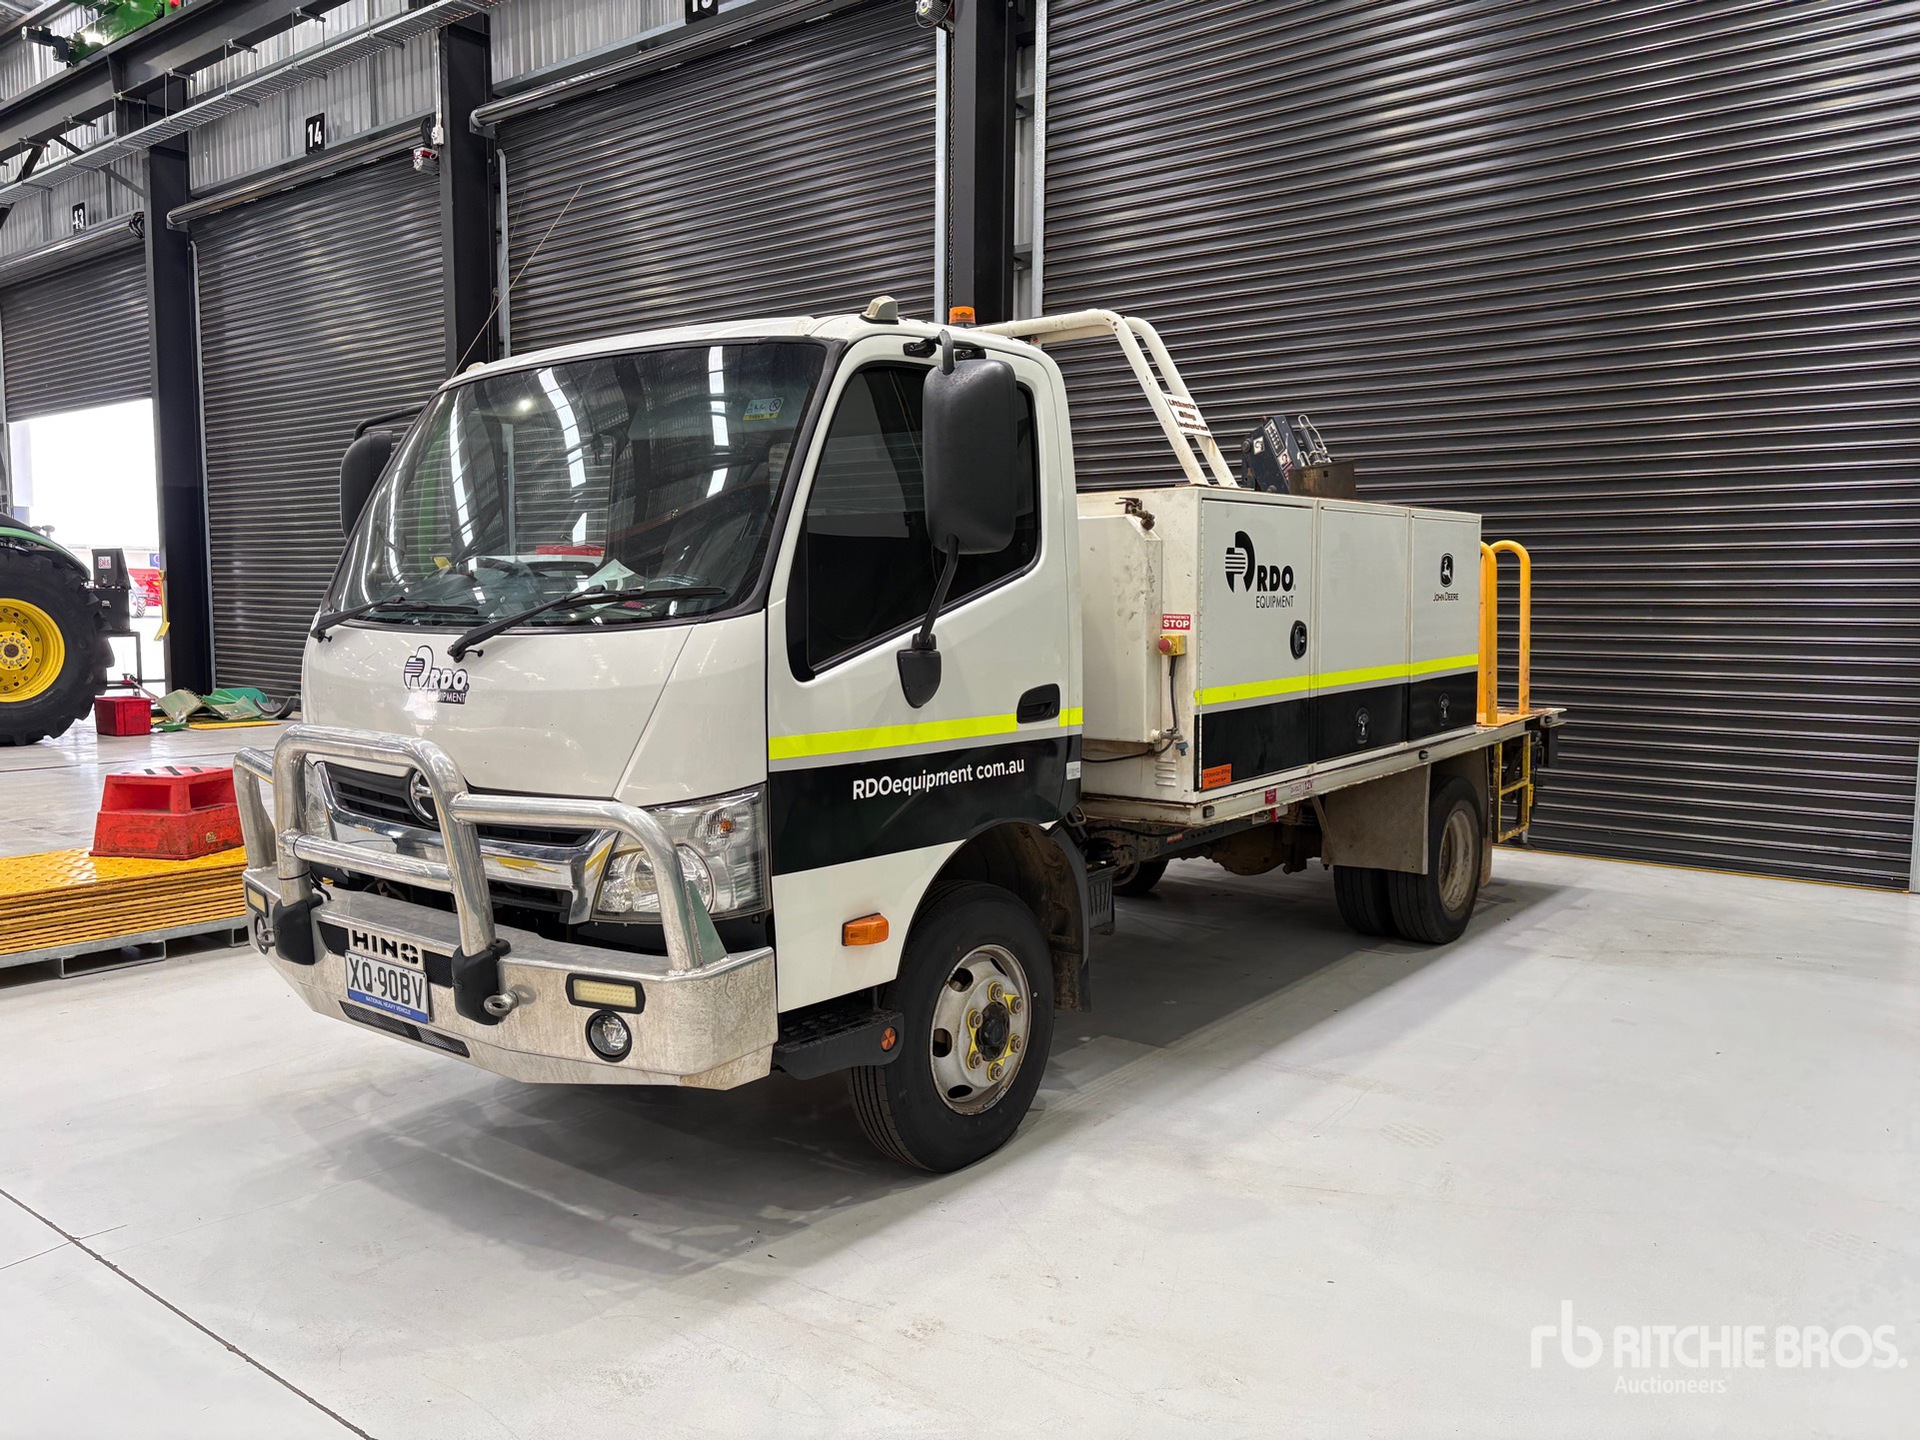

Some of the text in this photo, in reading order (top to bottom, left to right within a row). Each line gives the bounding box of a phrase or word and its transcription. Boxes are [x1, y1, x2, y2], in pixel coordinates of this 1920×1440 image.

[308, 121, 322, 148] 14
[1257, 565, 1294, 592] RDO
[1256, 595, 1294, 609] EQUIPMENT
[1163, 619, 1190, 628] STOP
[428, 668, 468, 690] RDO
[427, 690, 466, 703] UIPMENT
[852, 758, 1025, 800] RDOequipment com.au
[352, 930, 419, 965] HINO
